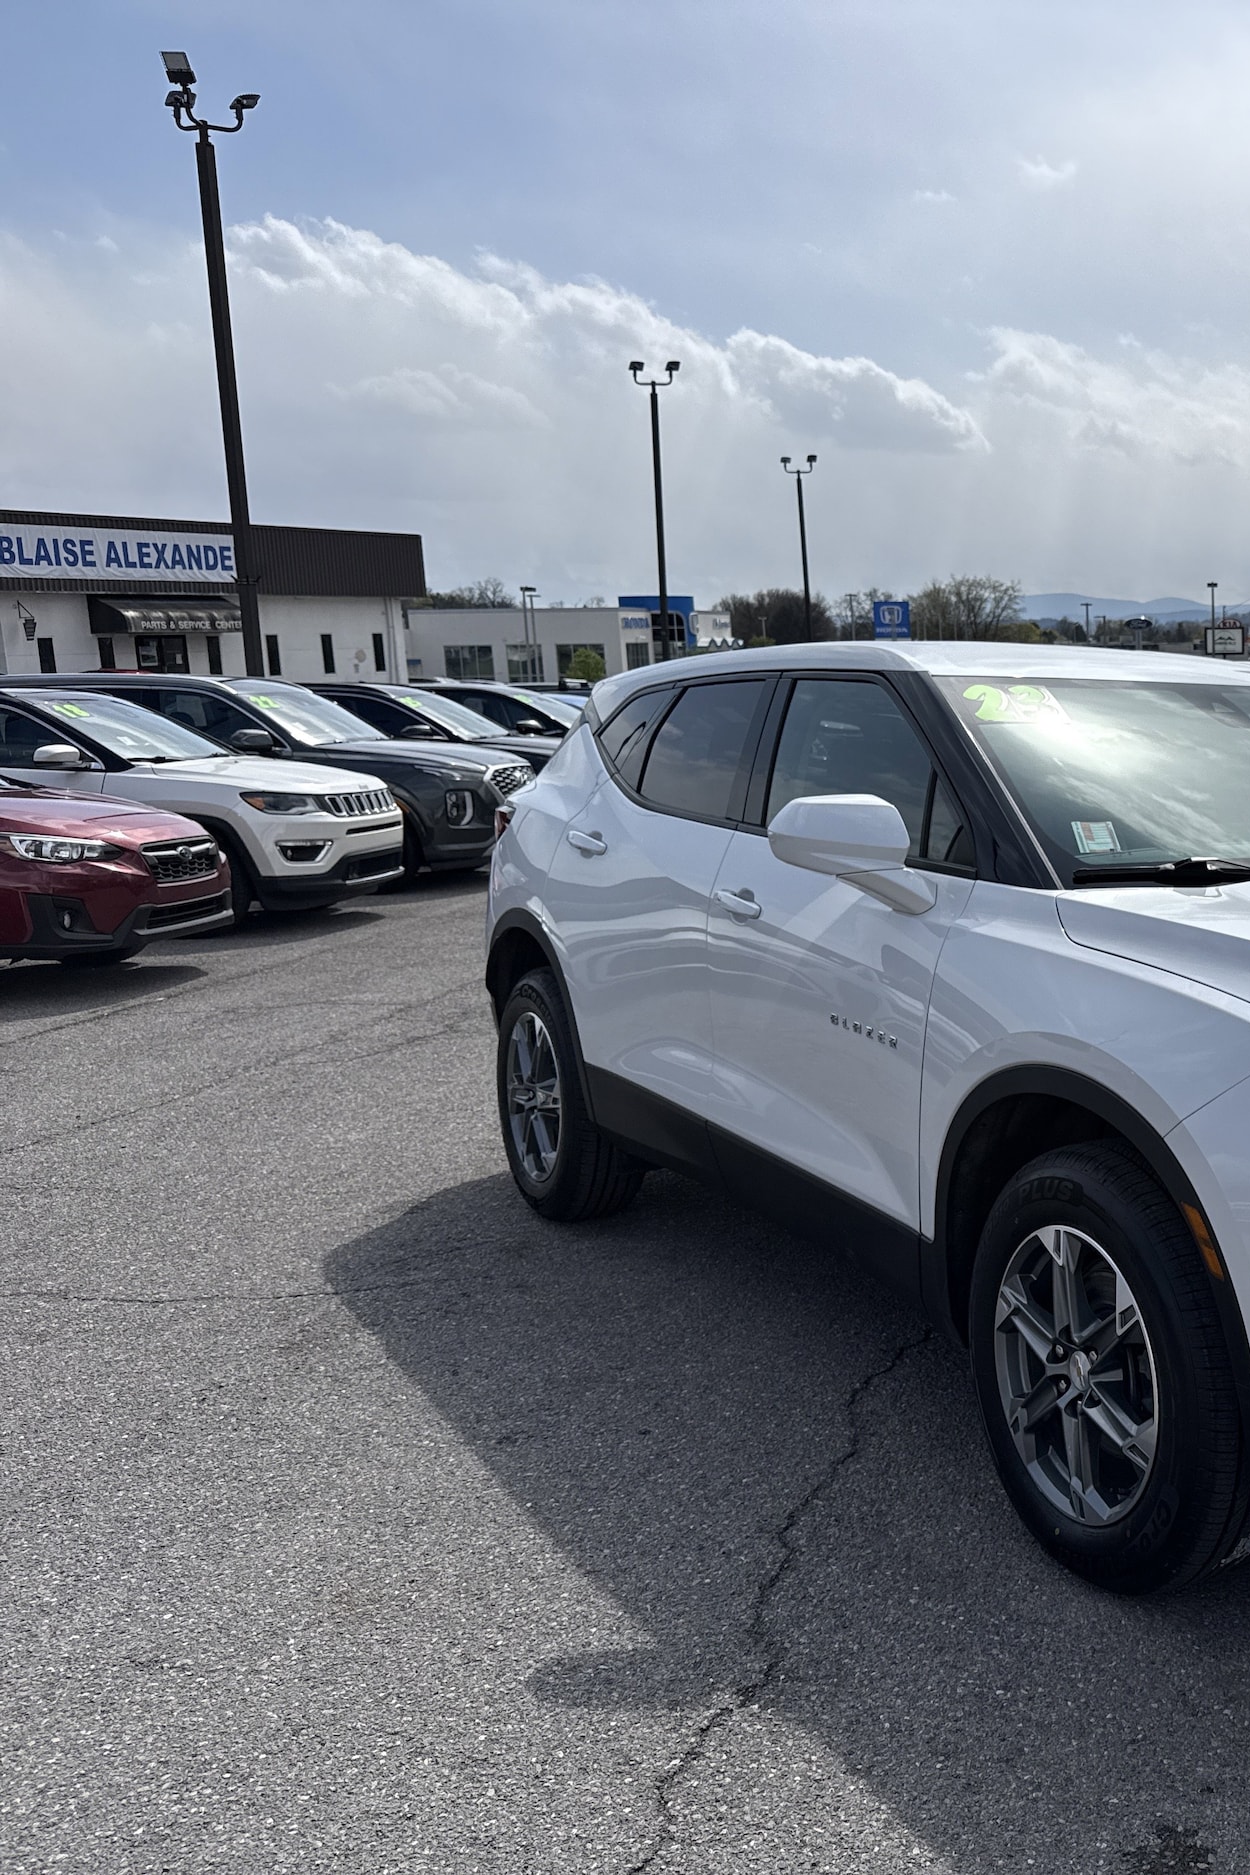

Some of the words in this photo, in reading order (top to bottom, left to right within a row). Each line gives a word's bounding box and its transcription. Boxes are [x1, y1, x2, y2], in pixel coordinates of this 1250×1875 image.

[0, 536, 96, 567] BLAISE
[105, 541, 234, 571] ALEXANDE
[141, 620, 167, 630] PARTS
[169, 621, 176, 629] &
[178, 621, 211, 630] SERVICE
[214, 621, 242, 630] CENTE
[830, 1012, 898, 1050] BLAZER
